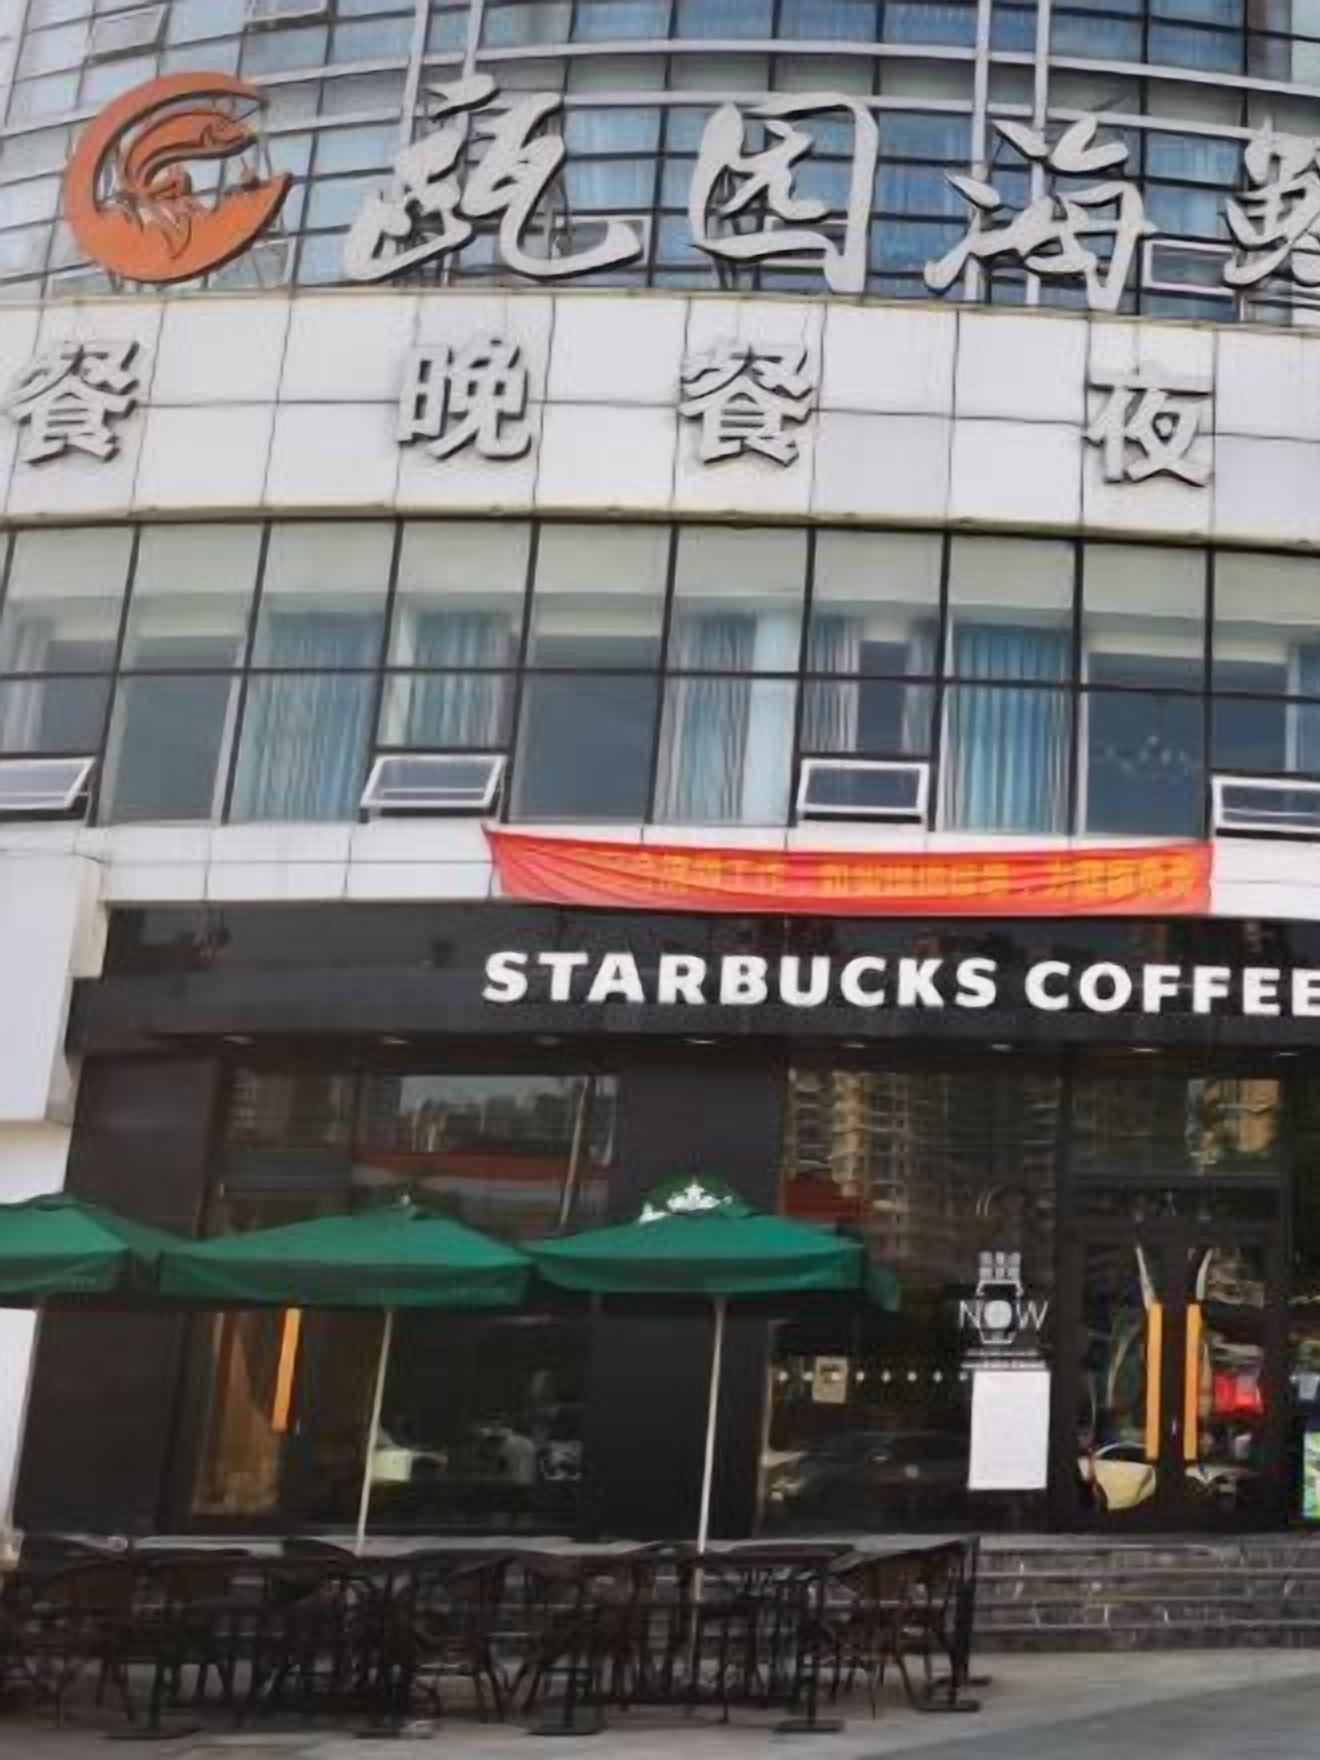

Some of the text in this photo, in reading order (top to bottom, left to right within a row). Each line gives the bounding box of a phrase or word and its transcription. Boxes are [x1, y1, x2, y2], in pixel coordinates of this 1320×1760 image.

[10, 338, 141, 465] 餐
[397, 336, 816, 468] 晚餐
[482, 949, 1000, 1010] STARBUCKS
